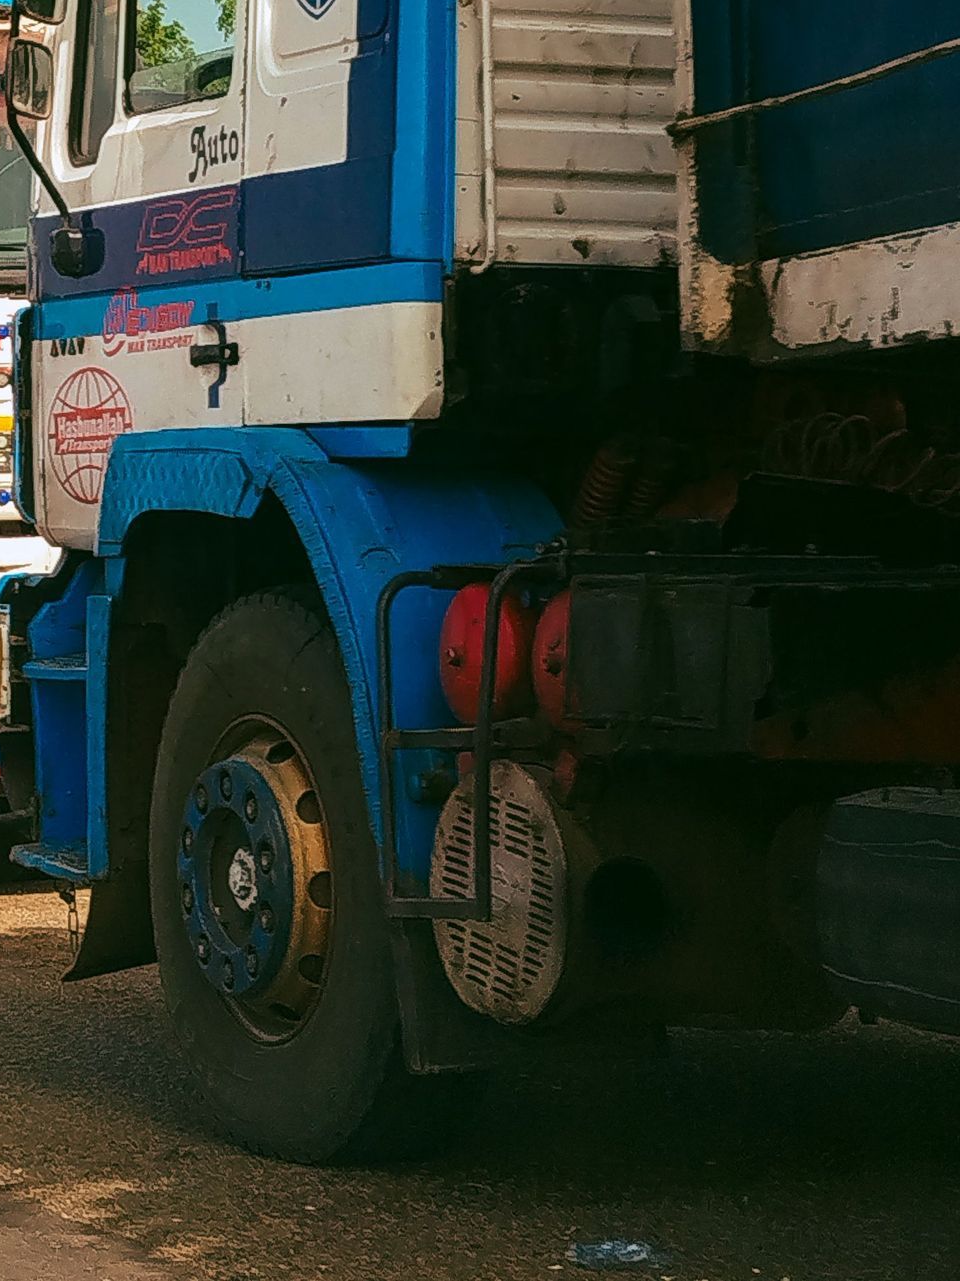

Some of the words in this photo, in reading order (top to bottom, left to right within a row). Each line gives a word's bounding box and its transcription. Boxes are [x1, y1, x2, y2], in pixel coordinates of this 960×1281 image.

[188, 125, 239, 183] Auto
[136, 189, 237, 253] DC
[147, 335, 194, 352] TRANSPORT
